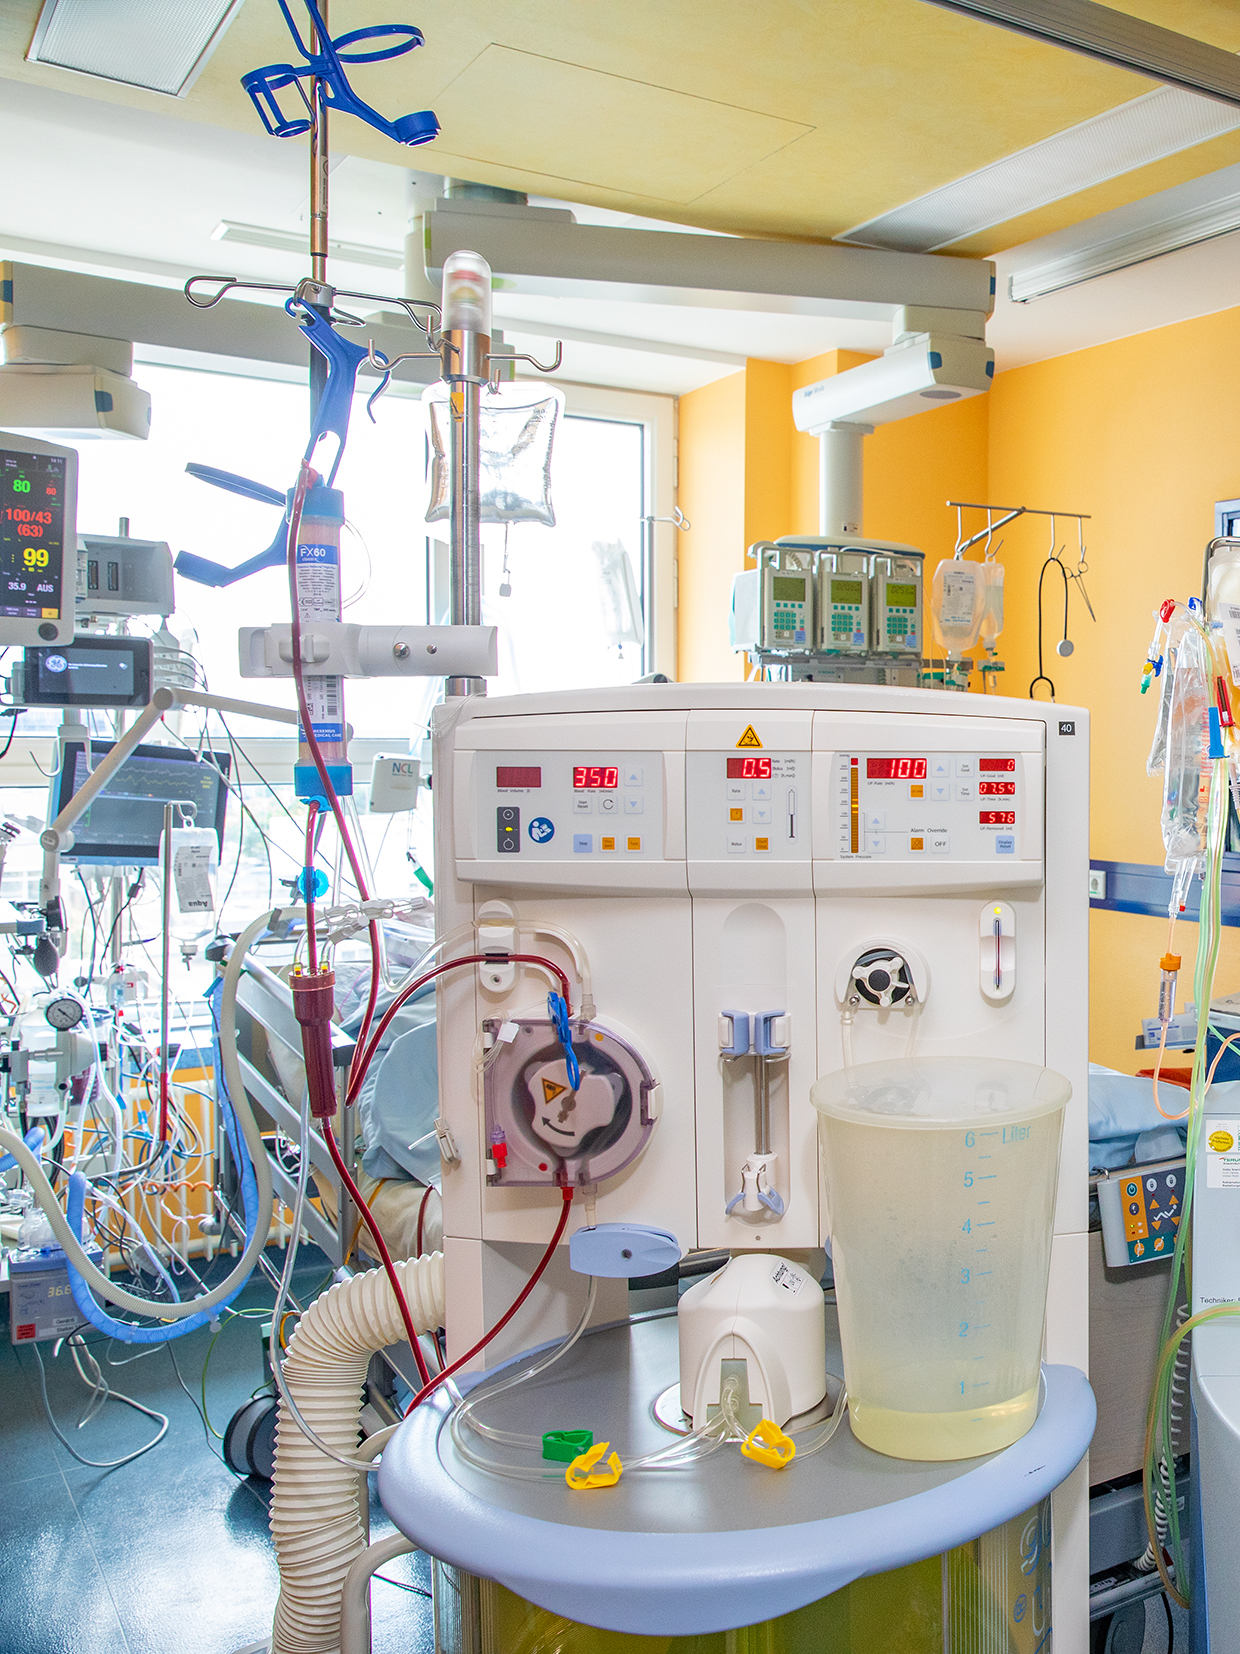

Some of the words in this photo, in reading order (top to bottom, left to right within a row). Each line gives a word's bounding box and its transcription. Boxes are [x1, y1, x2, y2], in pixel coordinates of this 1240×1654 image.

[13, 479, 31, 493] 80
[6, 508, 52, 524] 100/43
[17, 523, 43, 537] (63)
[23, 548, 49, 567] 99
[300, 547, 326, 557] FX60
[8, 582, 27, 591] 35.9
[36, 583, 54, 593] AUS
[1060, 723, 1072, 733] 40
[392, 763, 413, 774] NCL
[742, 758, 770, 778] 0.5
[890, 759, 927, 778] 100
[1007, 760, 1015, 771] 0
[575, 767, 618, 787] 350
[965, 1131, 975, 1148] 6
[1002, 1126, 1031, 1144] Liter
[963, 1171, 974, 1188] 5
[962, 1218, 972, 1234] 4
[960, 1268, 970, 1284] 3
[959, 1321, 969, 1337] 2
[959, 1380, 965, 1395] 1
